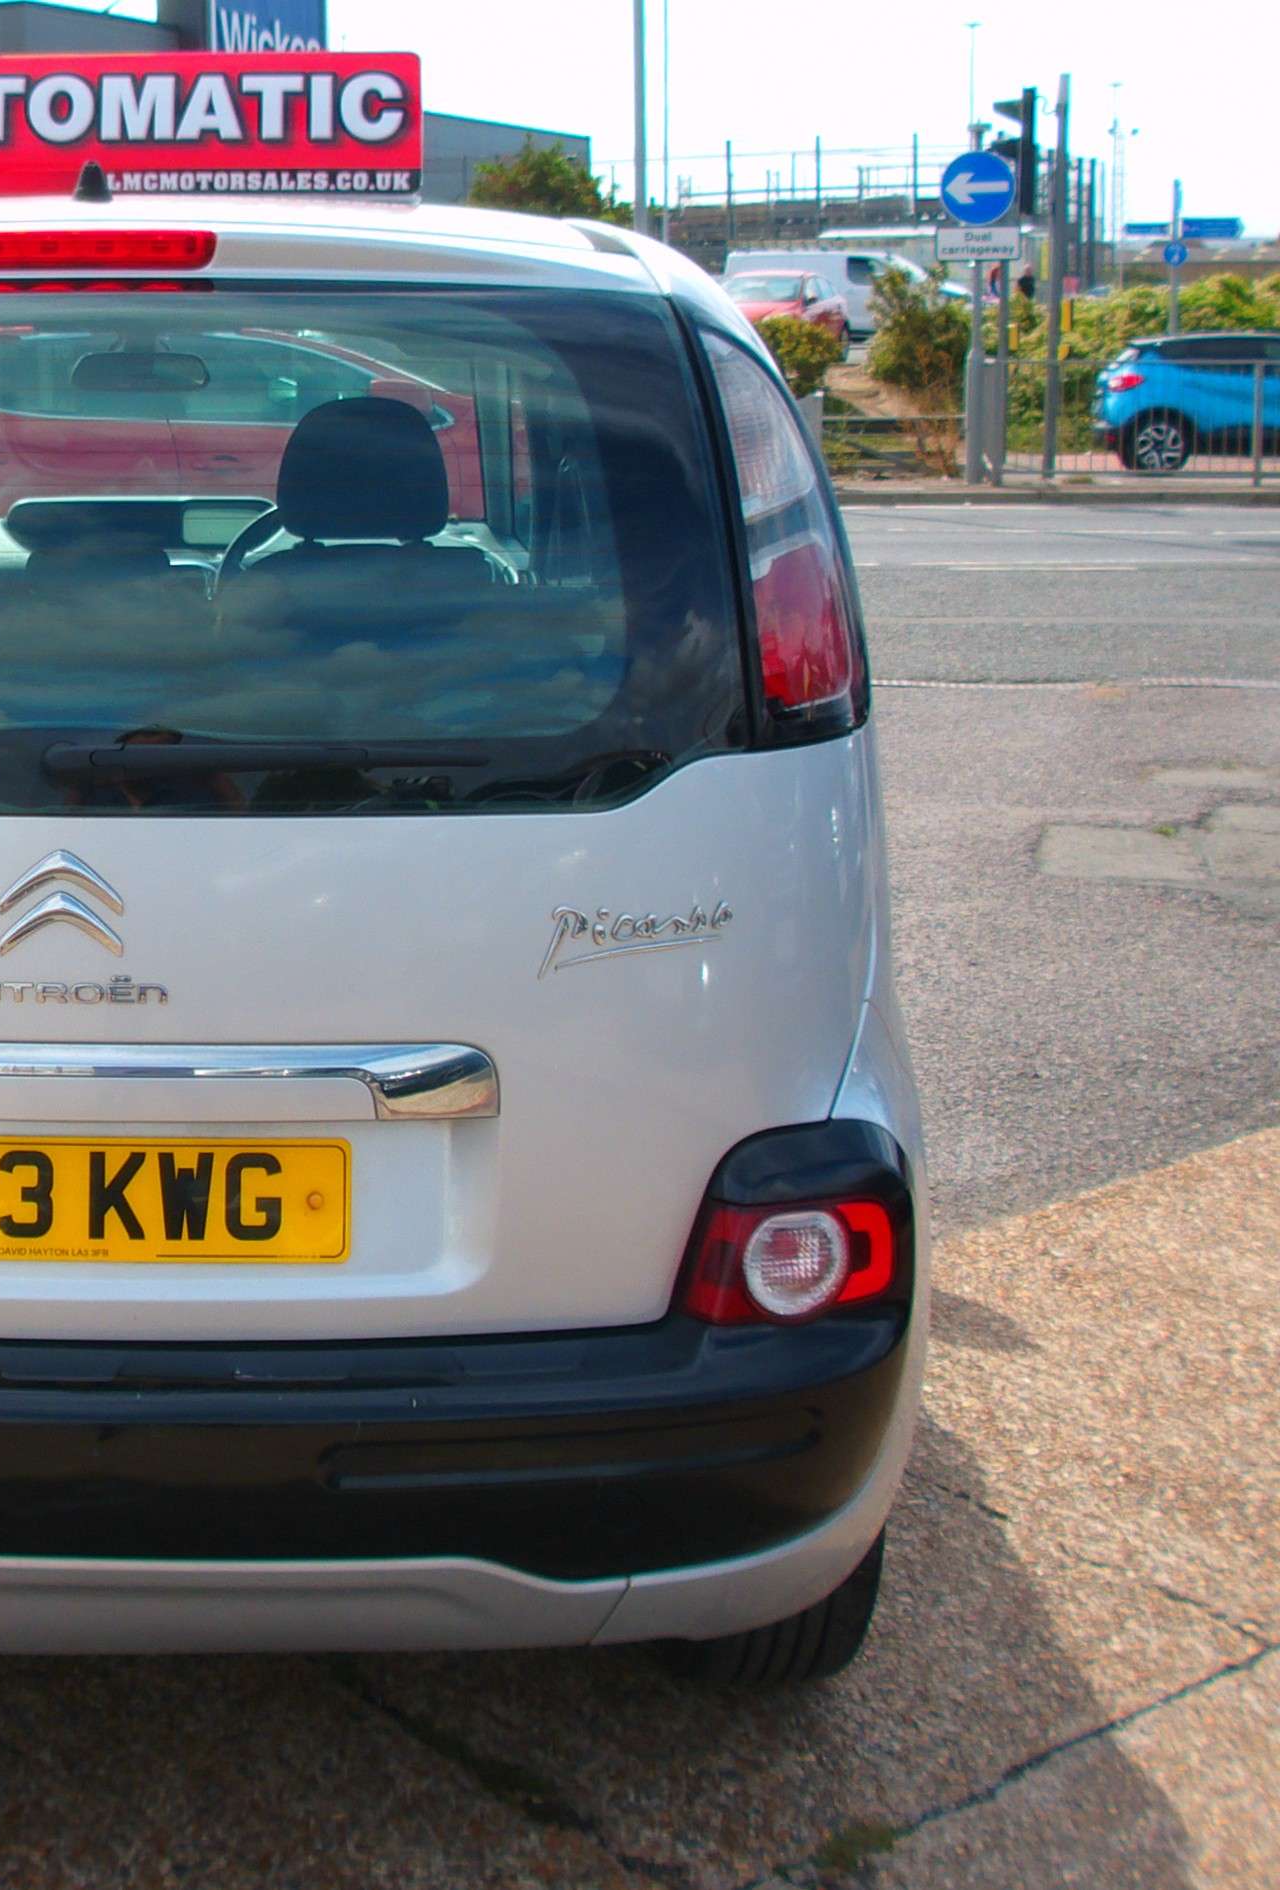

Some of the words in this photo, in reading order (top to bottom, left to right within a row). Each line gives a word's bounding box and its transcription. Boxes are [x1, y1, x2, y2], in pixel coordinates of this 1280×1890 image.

[106, 171, 411, 192] LMCMOTORSALES.CO.UK
[964, 231, 993, 241] Dual
[941, 244, 1014, 257] carriageway
[88, 1151, 283, 1242] KWG
